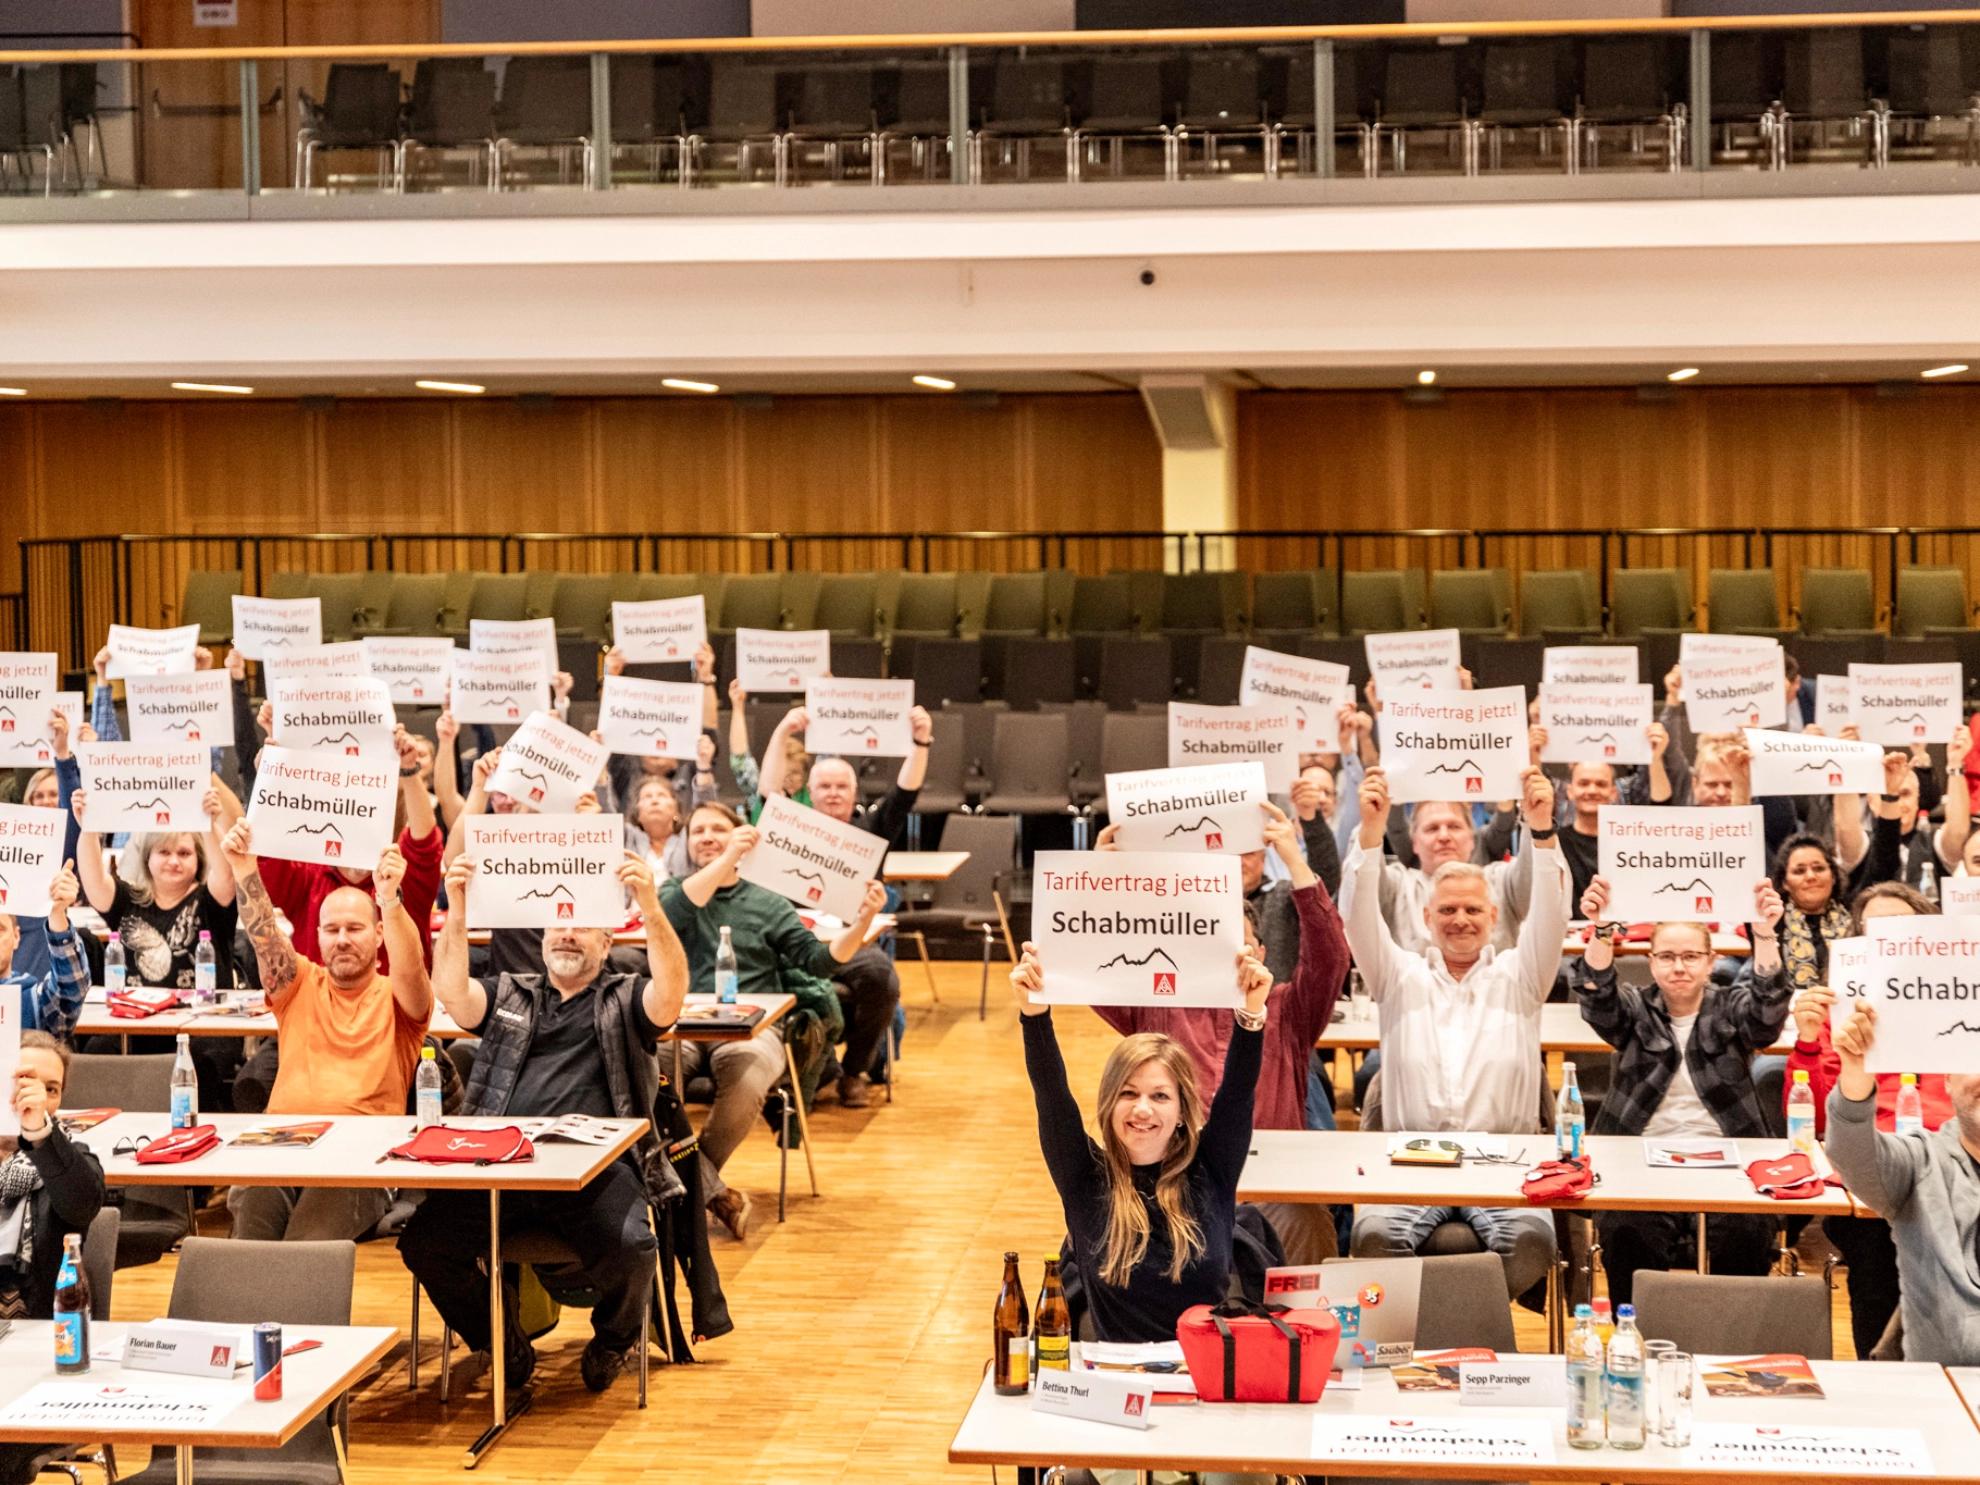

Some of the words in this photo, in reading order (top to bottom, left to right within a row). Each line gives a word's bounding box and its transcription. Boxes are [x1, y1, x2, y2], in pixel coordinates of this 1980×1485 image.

[239, 604, 286, 619] Tarifvertrag
[288, 606, 315, 619] jetzt!
[617, 608, 671, 621] Tarifvertrag
[242, 620, 310, 635] Schabmüller
[623, 622, 694, 635] Schabmüller
[117, 642, 186, 658] Schabmüller
[367, 646, 421, 658] Tarifvertrag
[424, 645, 450, 660] jetzt!
[742, 638, 796, 650] Tarifvertrag
[797, 638, 822, 651] jetzt!
[1371, 640, 1424, 654] Tarifvertrag
[1426, 639, 1453, 652] jetzt!
[268, 656, 331, 670] Tarifvertrag
[333, 653, 362, 666] jetzt!
[455, 658, 509, 674] Tarifvertrag
[512, 658, 540, 672] jetzt!
[746, 653, 817, 666] Schabmüller
[1377, 656, 1449, 670] Schabmüller
[1549, 656, 1606, 667] Tarifvertrag
[14, 664, 48, 677] jetzt!
[371, 662, 442, 674] Schabmüller
[1250, 657, 1308, 681] Tarifvertrag
[1310, 670, 1342, 686] jetzt!
[1686, 665, 1752, 680] Tarifvertrag
[1753, 660, 1778, 674] jetzt!
[458, 679, 538, 693] Schabmüller
[1553, 673, 1627, 683] Schabmüller
[1856, 674, 1922, 688] Tarifvertrag
[1926, 674, 1954, 687] jetzt!
[131, 682, 192, 696] Tarifvertrag
[195, 680, 224, 694] jetzt!
[279, 689, 351, 704] Tarifvertrag
[354, 688, 387, 703] jetzt!
[606, 686, 665, 704] Tarifvertrag
[667, 691, 695, 704] jetzt!
[812, 687, 874, 702] Tarifvertrag
[876, 688, 906, 701] jetzt!
[1250, 678, 1332, 706] Schabmüller
[1696, 681, 1774, 700] Schabmüller
[139, 700, 219, 715] Schabmüller
[1547, 694, 1608, 708] Tarifvertrag
[1611, 694, 1644, 706] jetzt!
[1861, 695, 1948, 708] Schabmüller
[283, 712, 384, 727] Schabmüller
[609, 706, 689, 724] Schabmüller
[816, 707, 899, 721] Schabmüller
[1390, 702, 1476, 723] Tarifvertrag
[1478, 702, 1518, 720] jetzt!
[1176, 716, 1251, 733] Tarifvertrag
[1254, 716, 1289, 731] jetzt!
[1552, 714, 1638, 728] Schabmüller
[1182, 739, 1283, 754] Schabmüller
[1396, 731, 1513, 751] Schabmüller
[87, 753, 164, 769] Tarifvertrag
[167, 753, 201, 768] jetzt!
[504, 739, 582, 784] Schabmüller
[565, 742, 598, 766] jetzt!
[261, 760, 342, 788] Tarifvertrag
[345, 771, 388, 790] jetzt!
[94, 776, 196, 791] Schabmüller
[257, 788, 378, 818] Schabmüller
[1126, 788, 1247, 816] Schabmüller
[12, 821, 55, 837] jetzt!
[473, 828, 567, 846] Tarifvertrag
[571, 829, 613, 845] jetzt!
[770, 806, 840, 846] Tarifvertrag
[841, 836, 876, 860] jetzt!
[1607, 821, 1704, 841] Tarifvertrag
[1709, 821, 1753, 839] jetzt!
[766, 831, 859, 879] Schabmüller
[1616, 851, 1746, 869] Schabmüller
[482, 858, 606, 876] Schabmüller
[1043, 871, 1167, 896] Tarifvertrag
[1173, 874, 1229, 896] jetzt!
[1052, 911, 1220, 935] Schabmüller
[1877, 938, 1980, 957] Tarifvertr
[1268, 1275, 1319, 1292] FREI
[1365, 1289, 1378, 1303] 35
[130, 1338, 155, 1349] Florian
[156, 1340, 177, 1350] Bauer
[1466, 1374, 1488, 1385] Sepp
[1490, 1374, 1531, 1384] Parzinger
[1042, 1381, 1068, 1393] Bettina
[1070, 1385, 1089, 1397] Thurl
